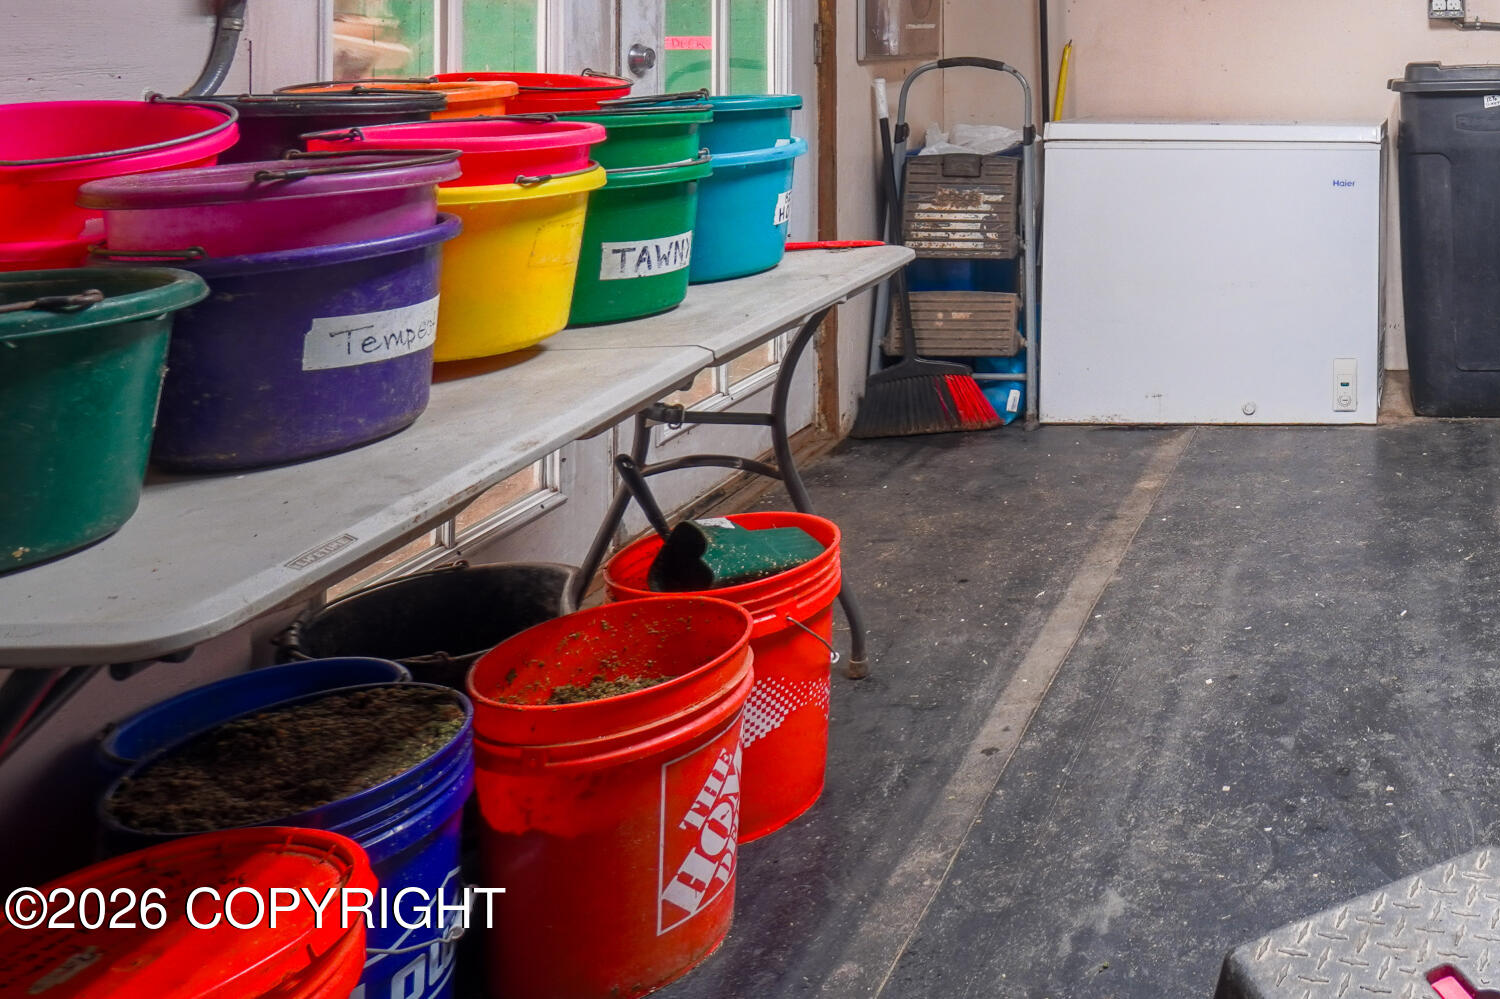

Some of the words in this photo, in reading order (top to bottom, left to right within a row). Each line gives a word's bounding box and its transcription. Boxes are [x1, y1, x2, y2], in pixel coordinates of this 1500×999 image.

[1332, 179, 1355, 187] Haier
[663, 743, 742, 915] HOM
[679, 748, 733, 831] THE
